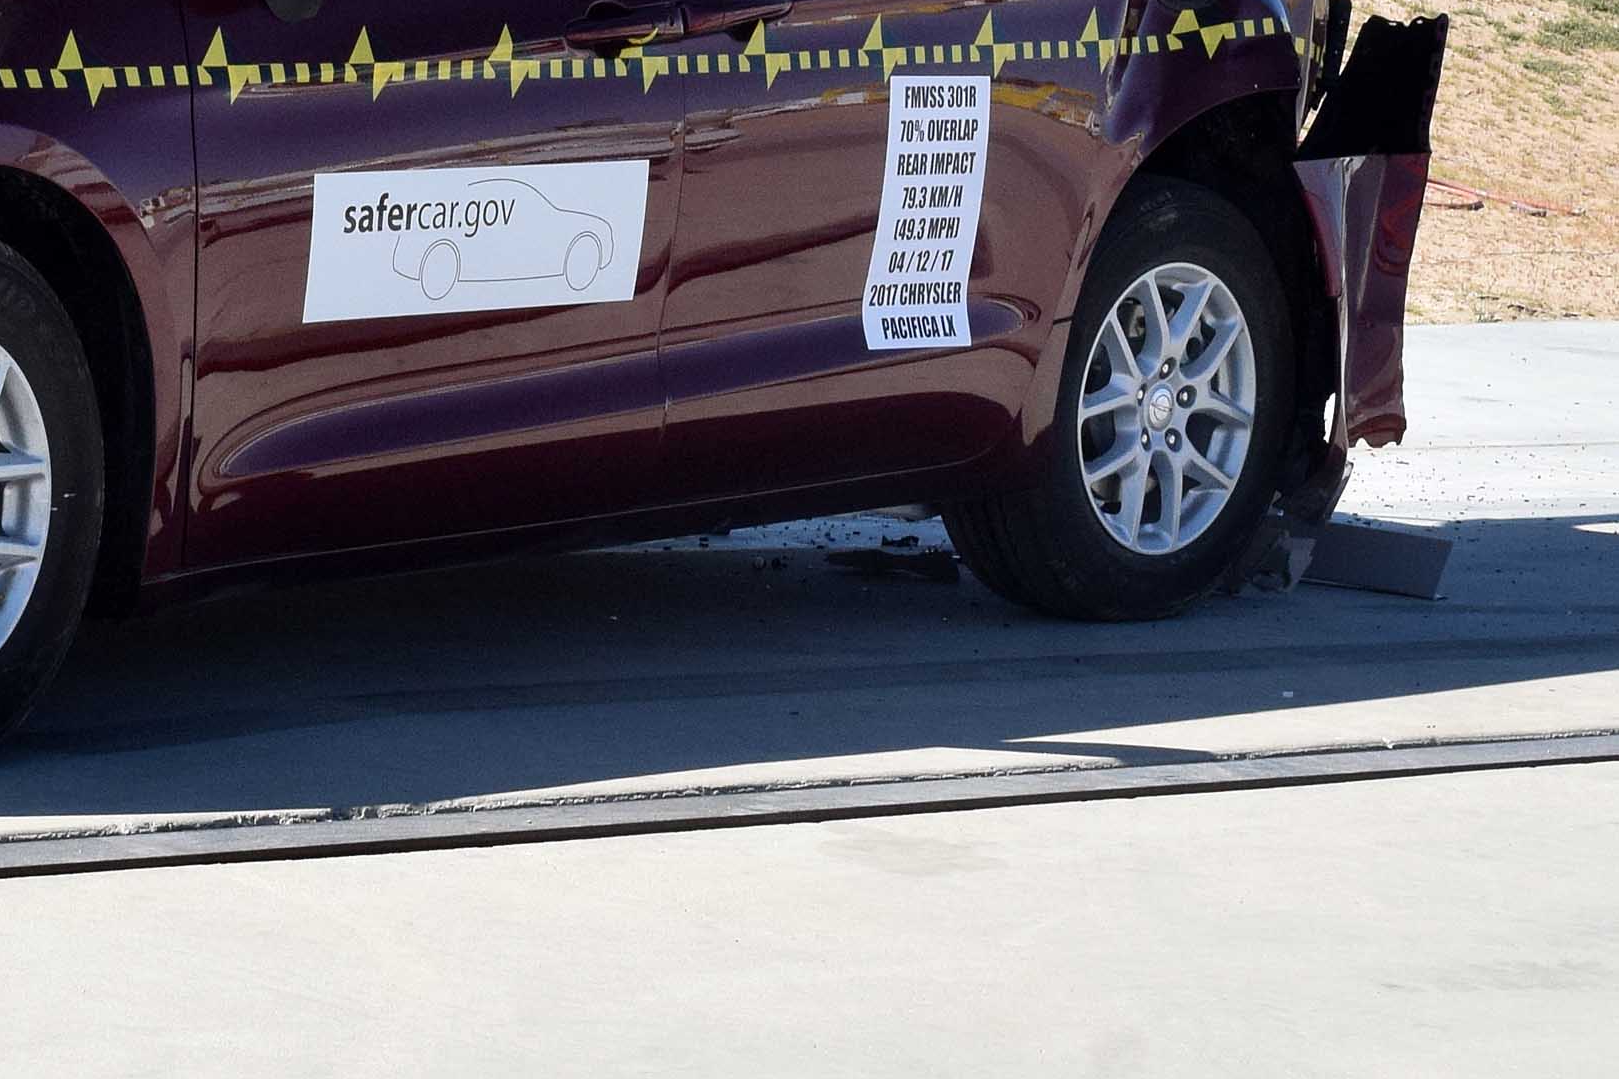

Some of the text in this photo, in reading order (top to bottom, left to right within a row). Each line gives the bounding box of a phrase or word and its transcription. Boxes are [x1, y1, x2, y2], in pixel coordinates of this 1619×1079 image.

[904, 85, 977, 109] FMVSS 301R
[900, 119, 979, 142] 70% OVERLAP
[897, 152, 976, 176] REAR IMPACT
[901, 185, 963, 209] 79.3 KM/H
[343, 192, 516, 238] safercar.gov
[868, 282, 962, 307] 2017 CHRYSLER
[881, 315, 957, 340] PACIFICA LX
